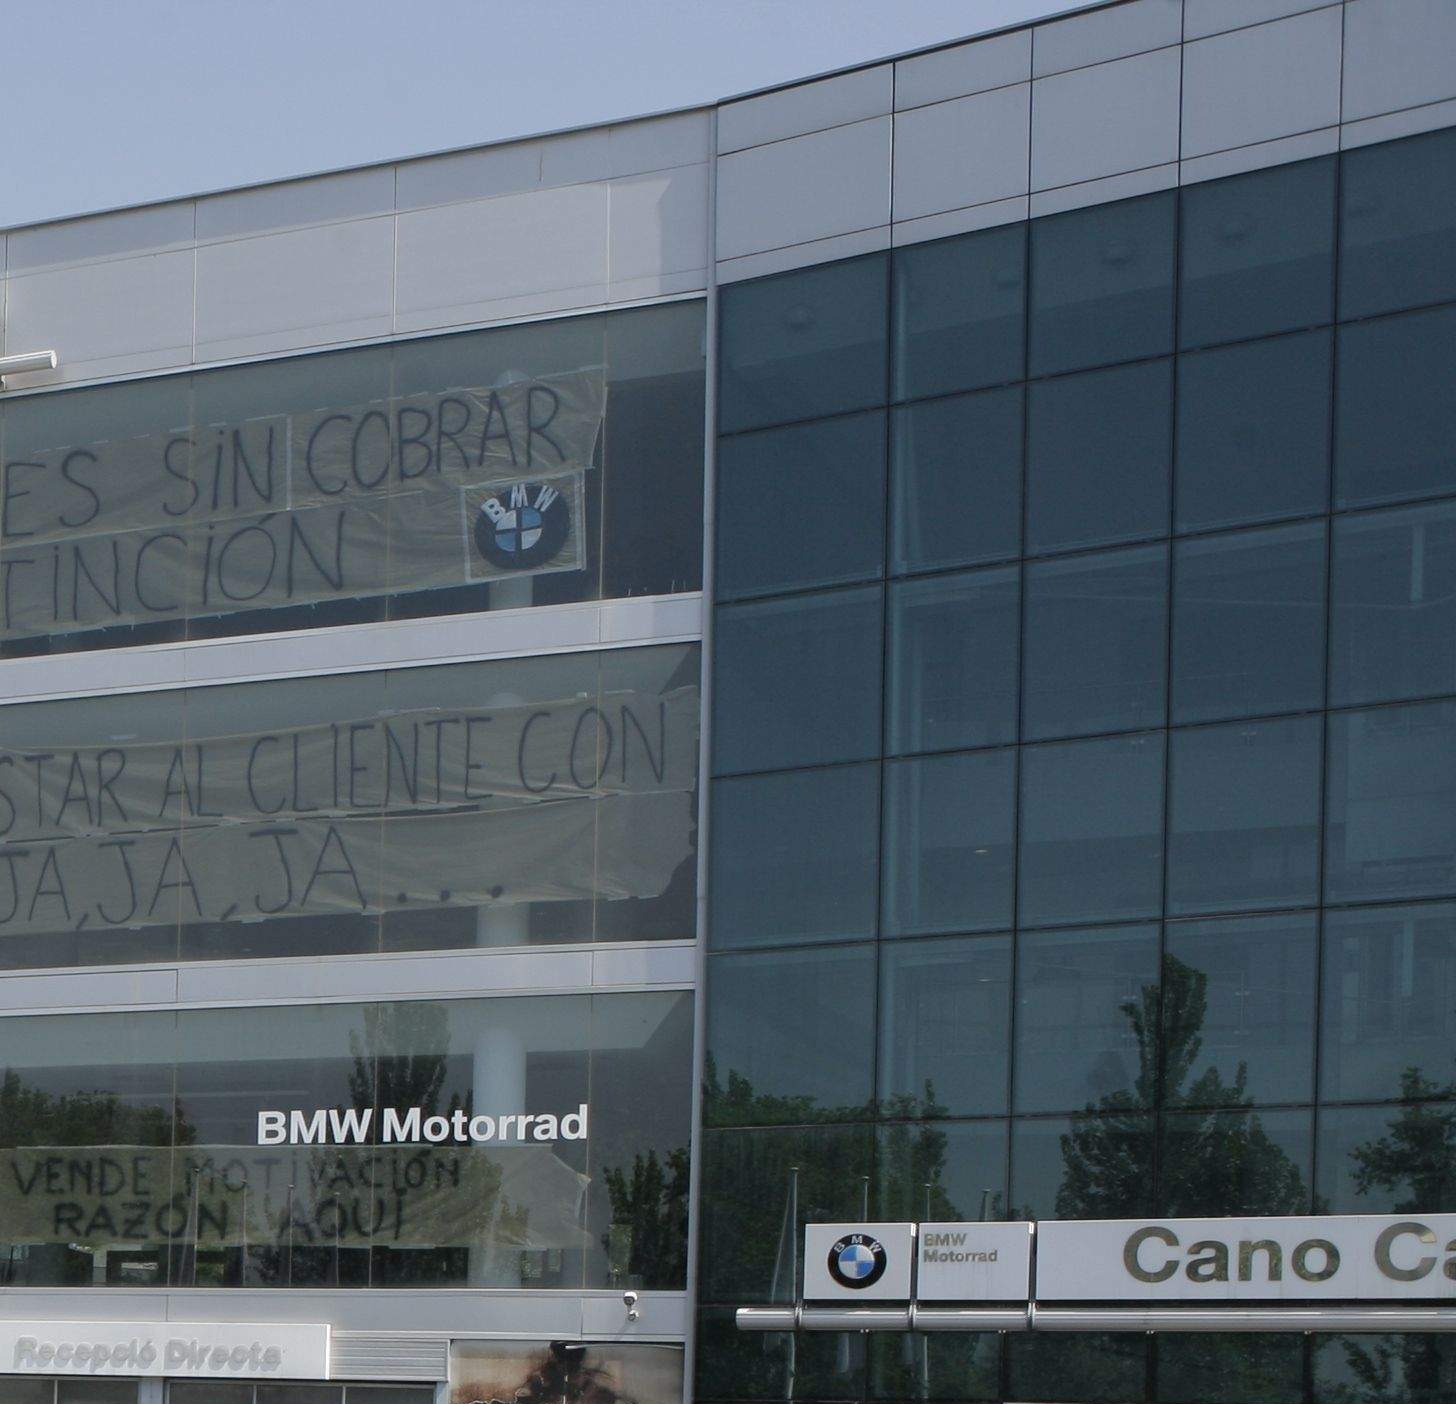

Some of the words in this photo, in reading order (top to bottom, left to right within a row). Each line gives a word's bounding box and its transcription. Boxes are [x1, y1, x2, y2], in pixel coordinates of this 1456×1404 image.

[161, 426, 276, 517] SIN
[303, 386, 564, 496] COBRAR
[156, 742, 224, 817] AL
[248, 718, 485, 813] CLIENTE
[517, 702, 666, 793] CON
[257, 1111, 374, 1145] BMW
[382, 1104, 589, 1143] Motorrad
[10, 1154, 149, 1196] VENDE
[834, 1235, 883, 1253] BMW
[923, 1250, 998, 1263] Motorrad
[924, 1233, 968, 1247] BMW
[1123, 1226, 1341, 1283] Cano
[13, 1335, 157, 1372] Recepció
[162, 1337, 282, 1371] Directa
